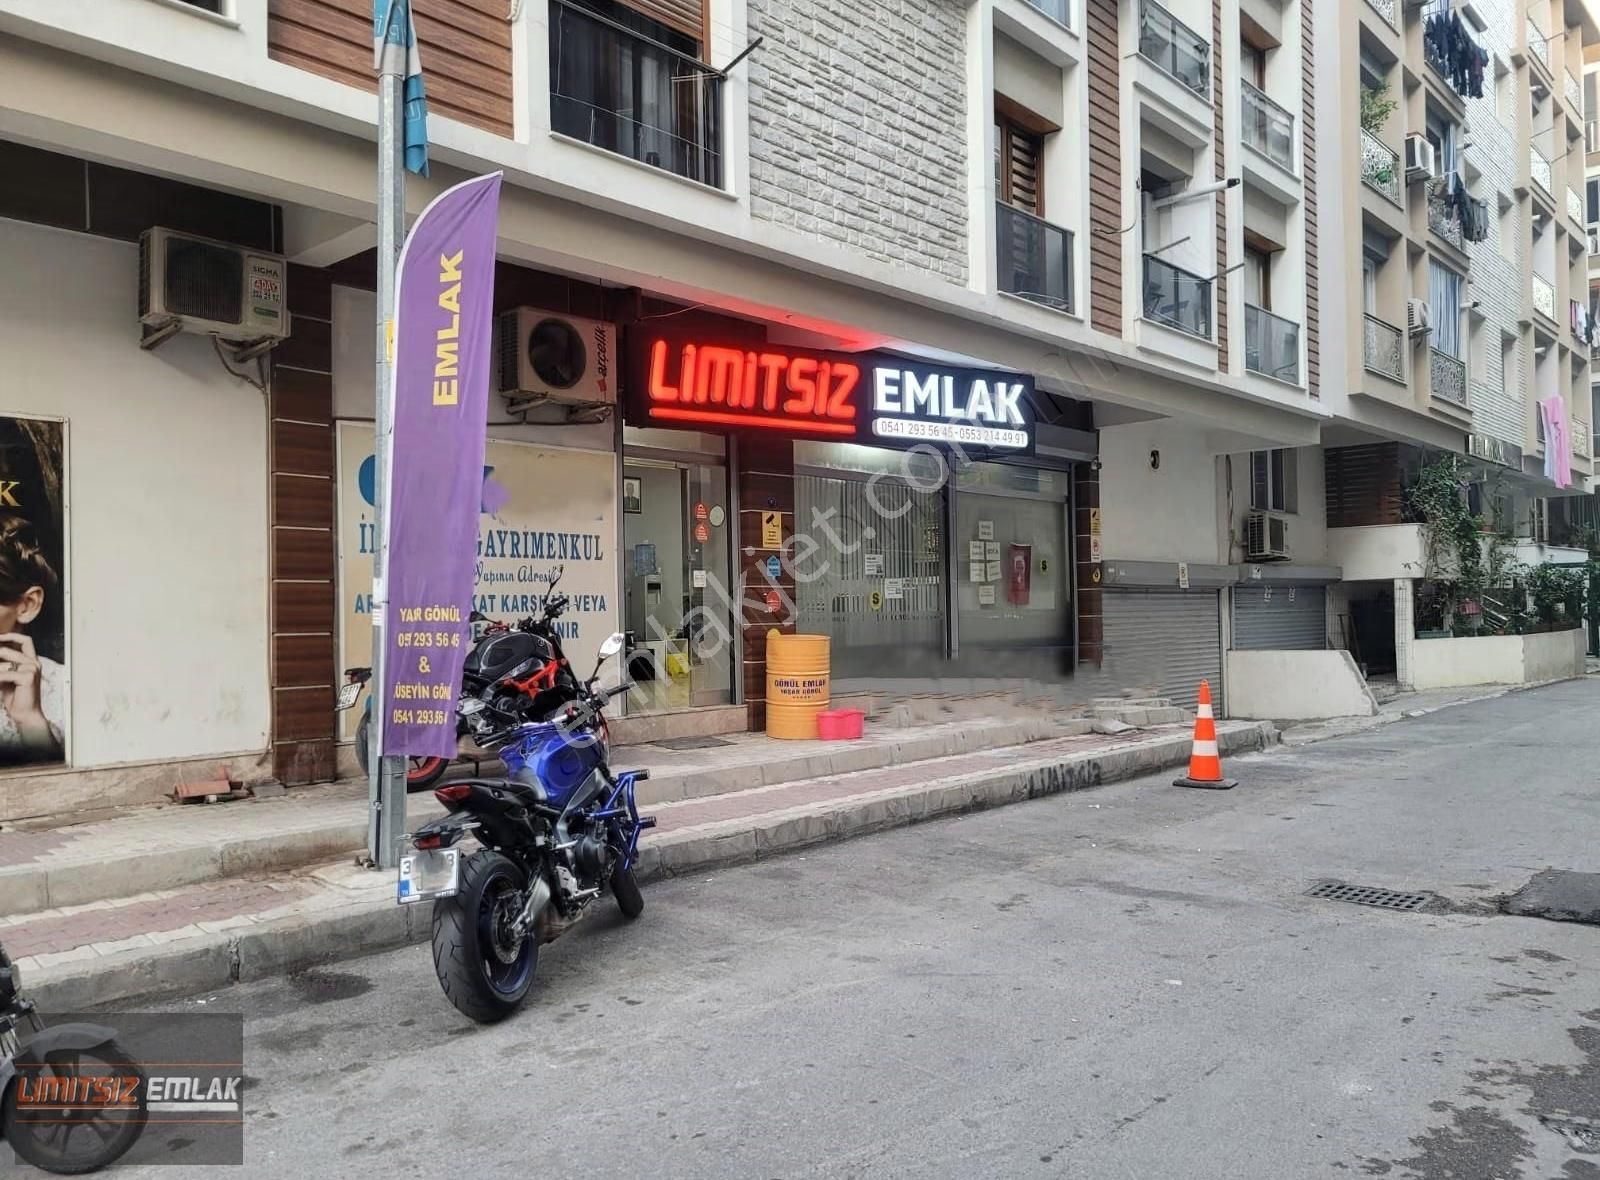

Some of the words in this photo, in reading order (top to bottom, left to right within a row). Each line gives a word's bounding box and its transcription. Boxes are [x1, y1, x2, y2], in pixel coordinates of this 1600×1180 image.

[432, 248, 464, 405] EMLAK
[872, 367, 1026, 425] EMLAK
[881, 420, 904, 434] 0541
[908, 422, 925, 435] 293
[928, 424, 939, 437] 56
[574, 595, 606, 611] VEYA
[425, 604, 461, 622] GÖNÜL
[414, 632, 433, 647] 293
[435, 632, 449, 647] 56
[418, 655, 431, 673] &
[393, 681, 430, 699] ÜSEYİN
[393, 709, 413, 724] 0541
[416, 709, 433, 724] 293
